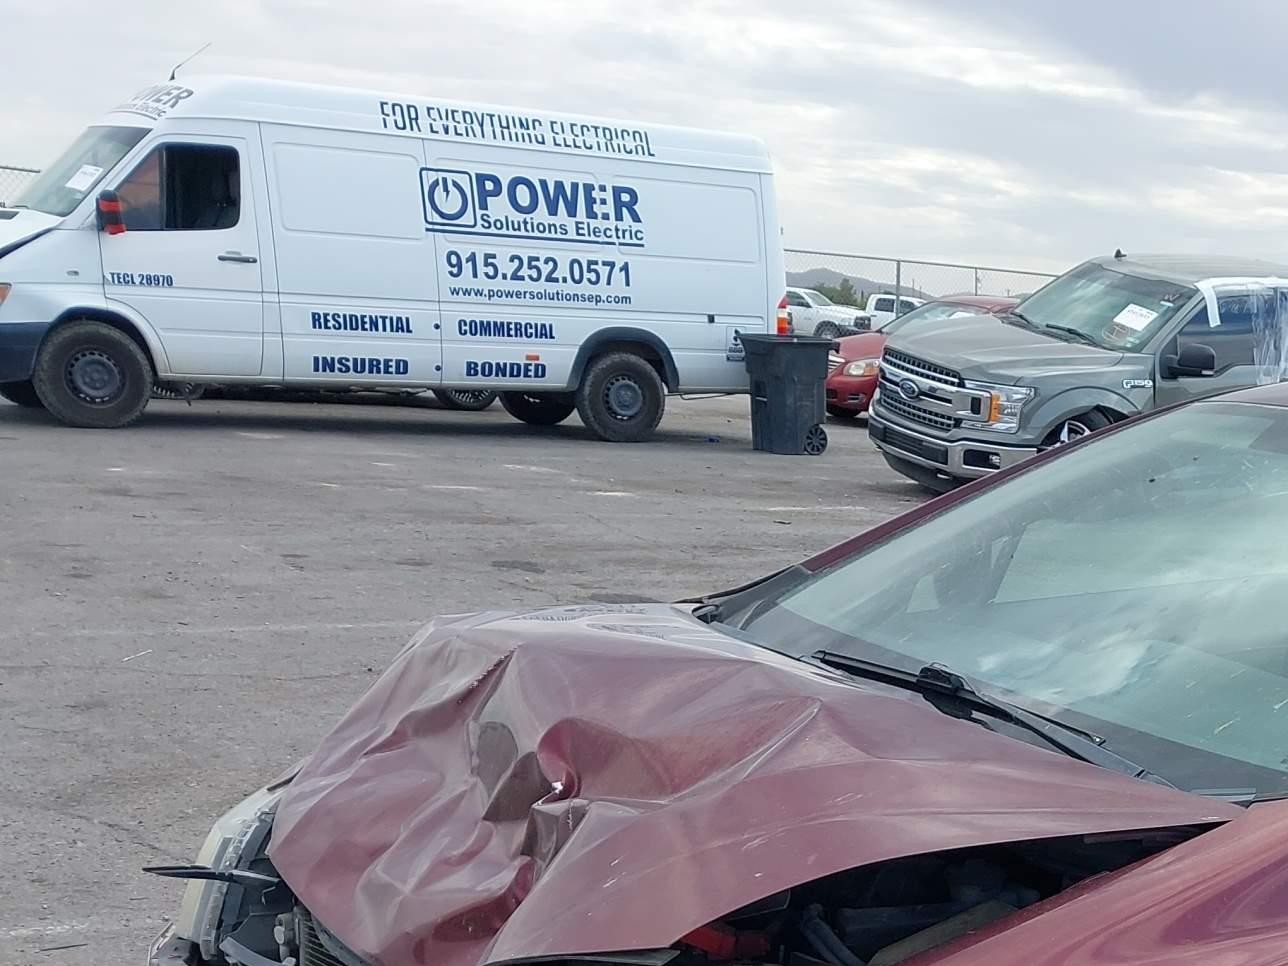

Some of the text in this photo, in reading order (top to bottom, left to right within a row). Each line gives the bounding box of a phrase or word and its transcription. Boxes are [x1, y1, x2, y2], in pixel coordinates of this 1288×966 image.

[379, 101, 656, 157] FOR EVERYTHING ELECTRICAL
[475, 172, 642, 223] POWER
[480, 213, 645, 241] Solutions Electric
[109, 272, 174, 287] TECL 28970
[446, 250, 632, 288] 915.252.0571
[448, 286, 632, 306] www.powersolutionsep.com
[311, 312, 556, 340] RESIDENTIAL COMMERCIAL
[312, 356, 547, 379] INSURED BONDED
